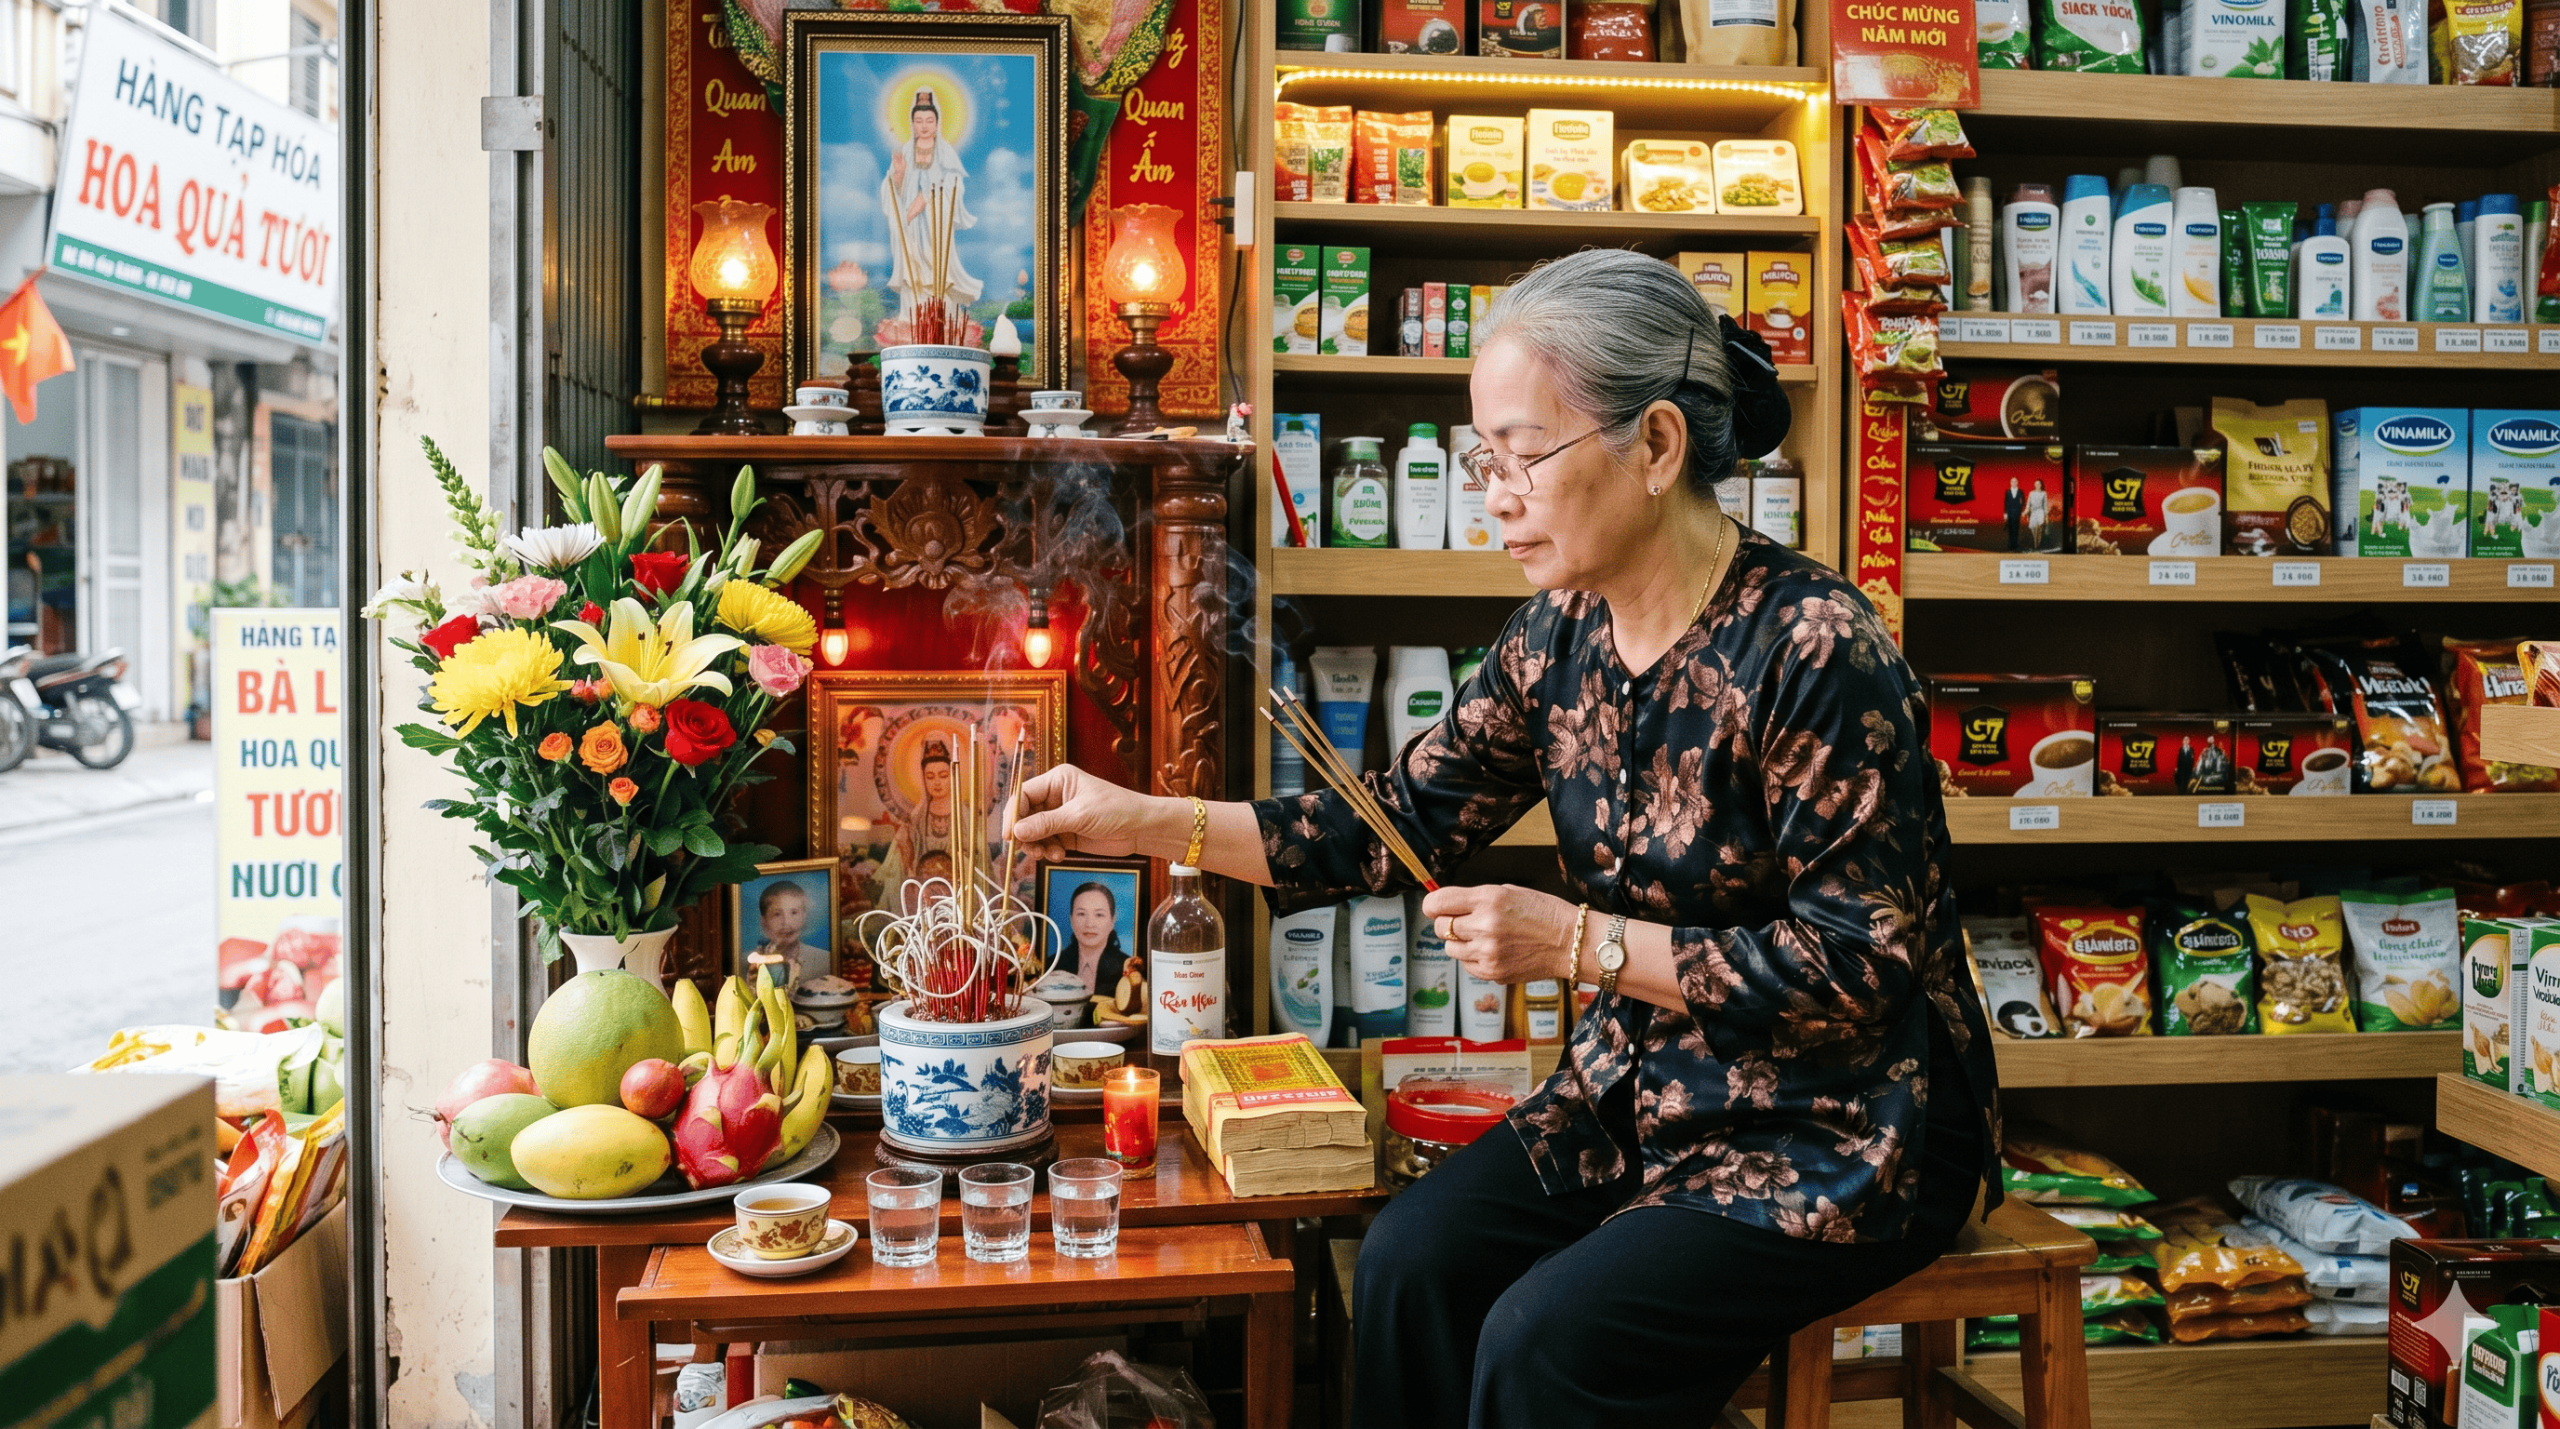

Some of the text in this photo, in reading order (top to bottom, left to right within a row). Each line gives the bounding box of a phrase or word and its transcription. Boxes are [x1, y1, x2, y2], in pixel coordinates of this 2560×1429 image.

[1847, 2, 1960, 24] CHÚC MỪNG
[1862, 25, 1946, 46] NĂM MỚI
[705, 78, 766, 118] Quan
[1124, 87, 1185, 126] Quan
[116, 58, 321, 189] HÀNG TẠP HÓA
[78, 139, 162, 231] HOA
[174, 173, 245, 259] QUẢ
[260, 212, 331, 286] TƯƠI
[2381, 426, 2449, 440] VINAMILK
[2494, 428, 2560, 442] VINAMILK
[1938, 466, 1972, 486] G7
[2106, 478, 2142, 500] G7
[241, 619, 303, 647] HÀNG
[238, 658, 298, 715] BÀ
[1965, 718, 2004, 742] G7
[241, 739, 299, 768] HOA
